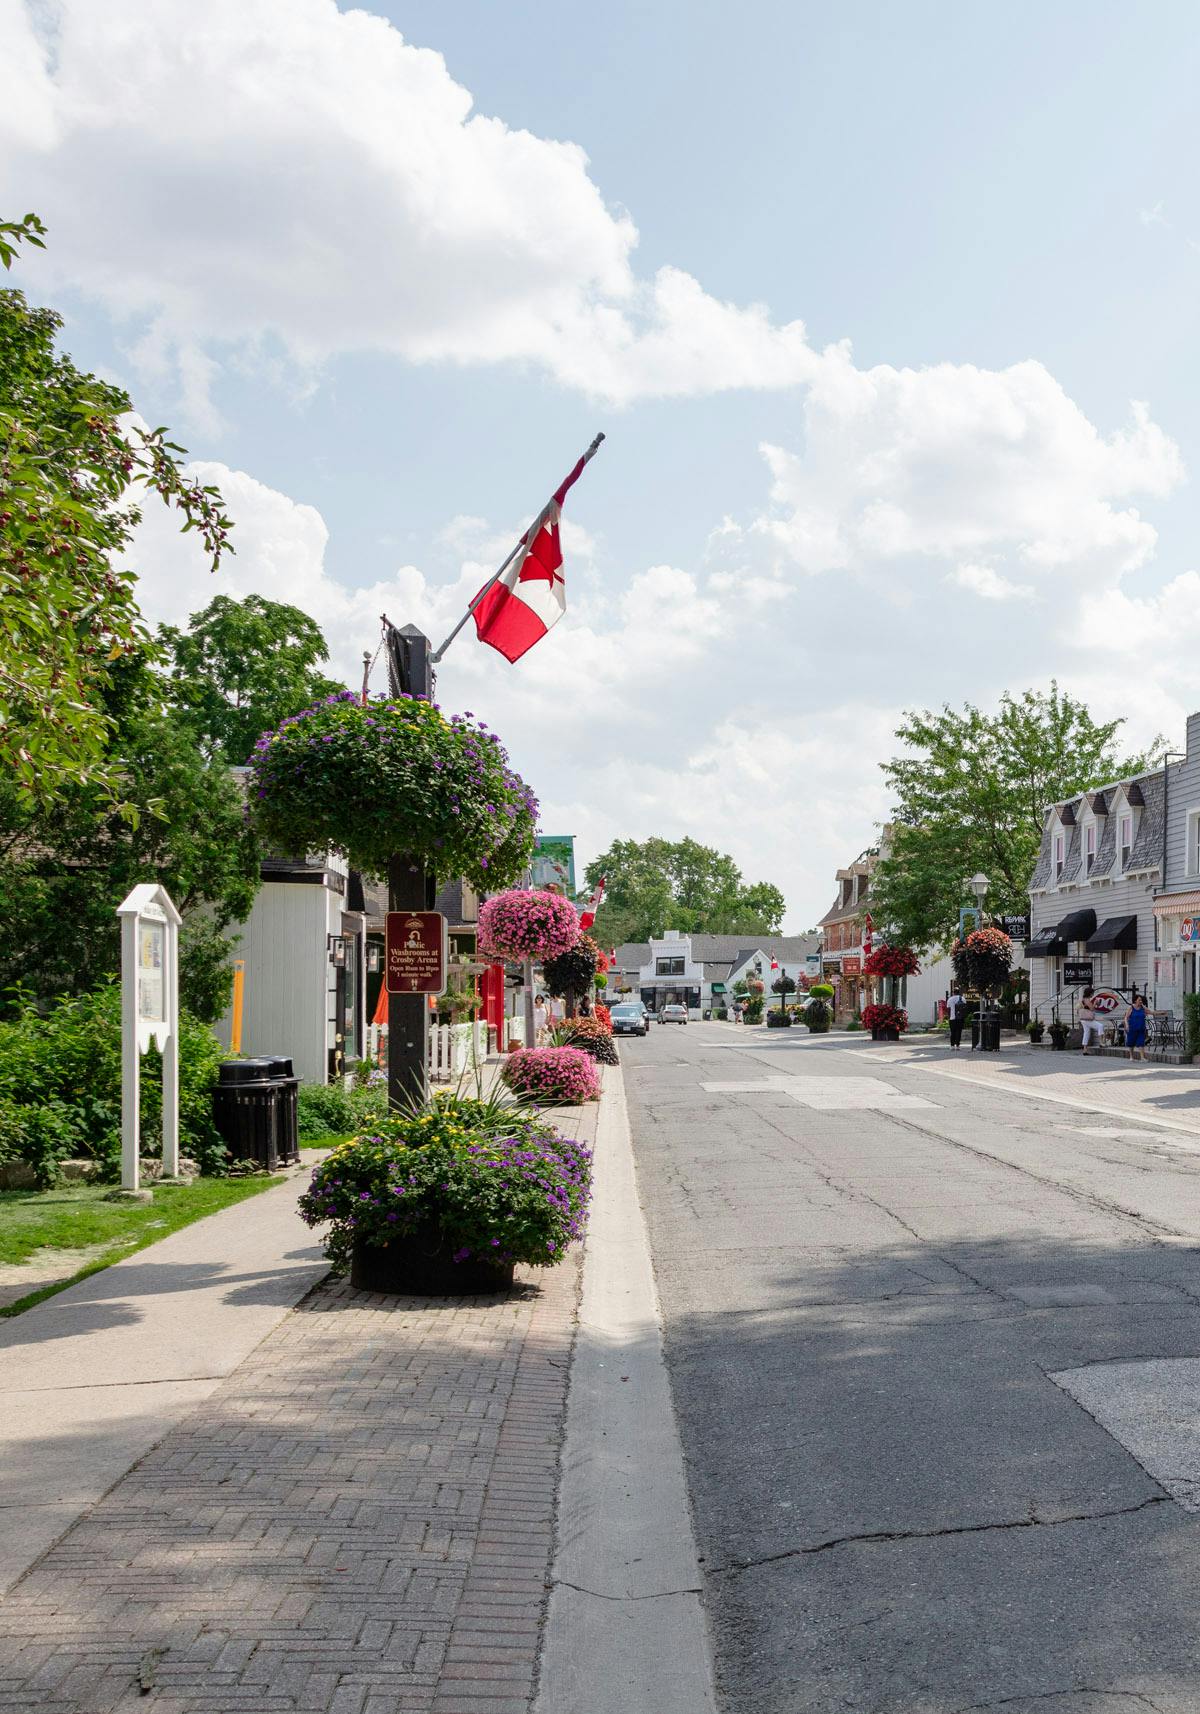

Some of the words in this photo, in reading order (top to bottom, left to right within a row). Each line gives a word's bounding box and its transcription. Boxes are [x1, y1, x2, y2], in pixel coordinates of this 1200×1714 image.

[404, 941, 425, 949] Plic
[391, 948, 430, 956] Washrooms
[391, 956, 414, 965] Crosby
